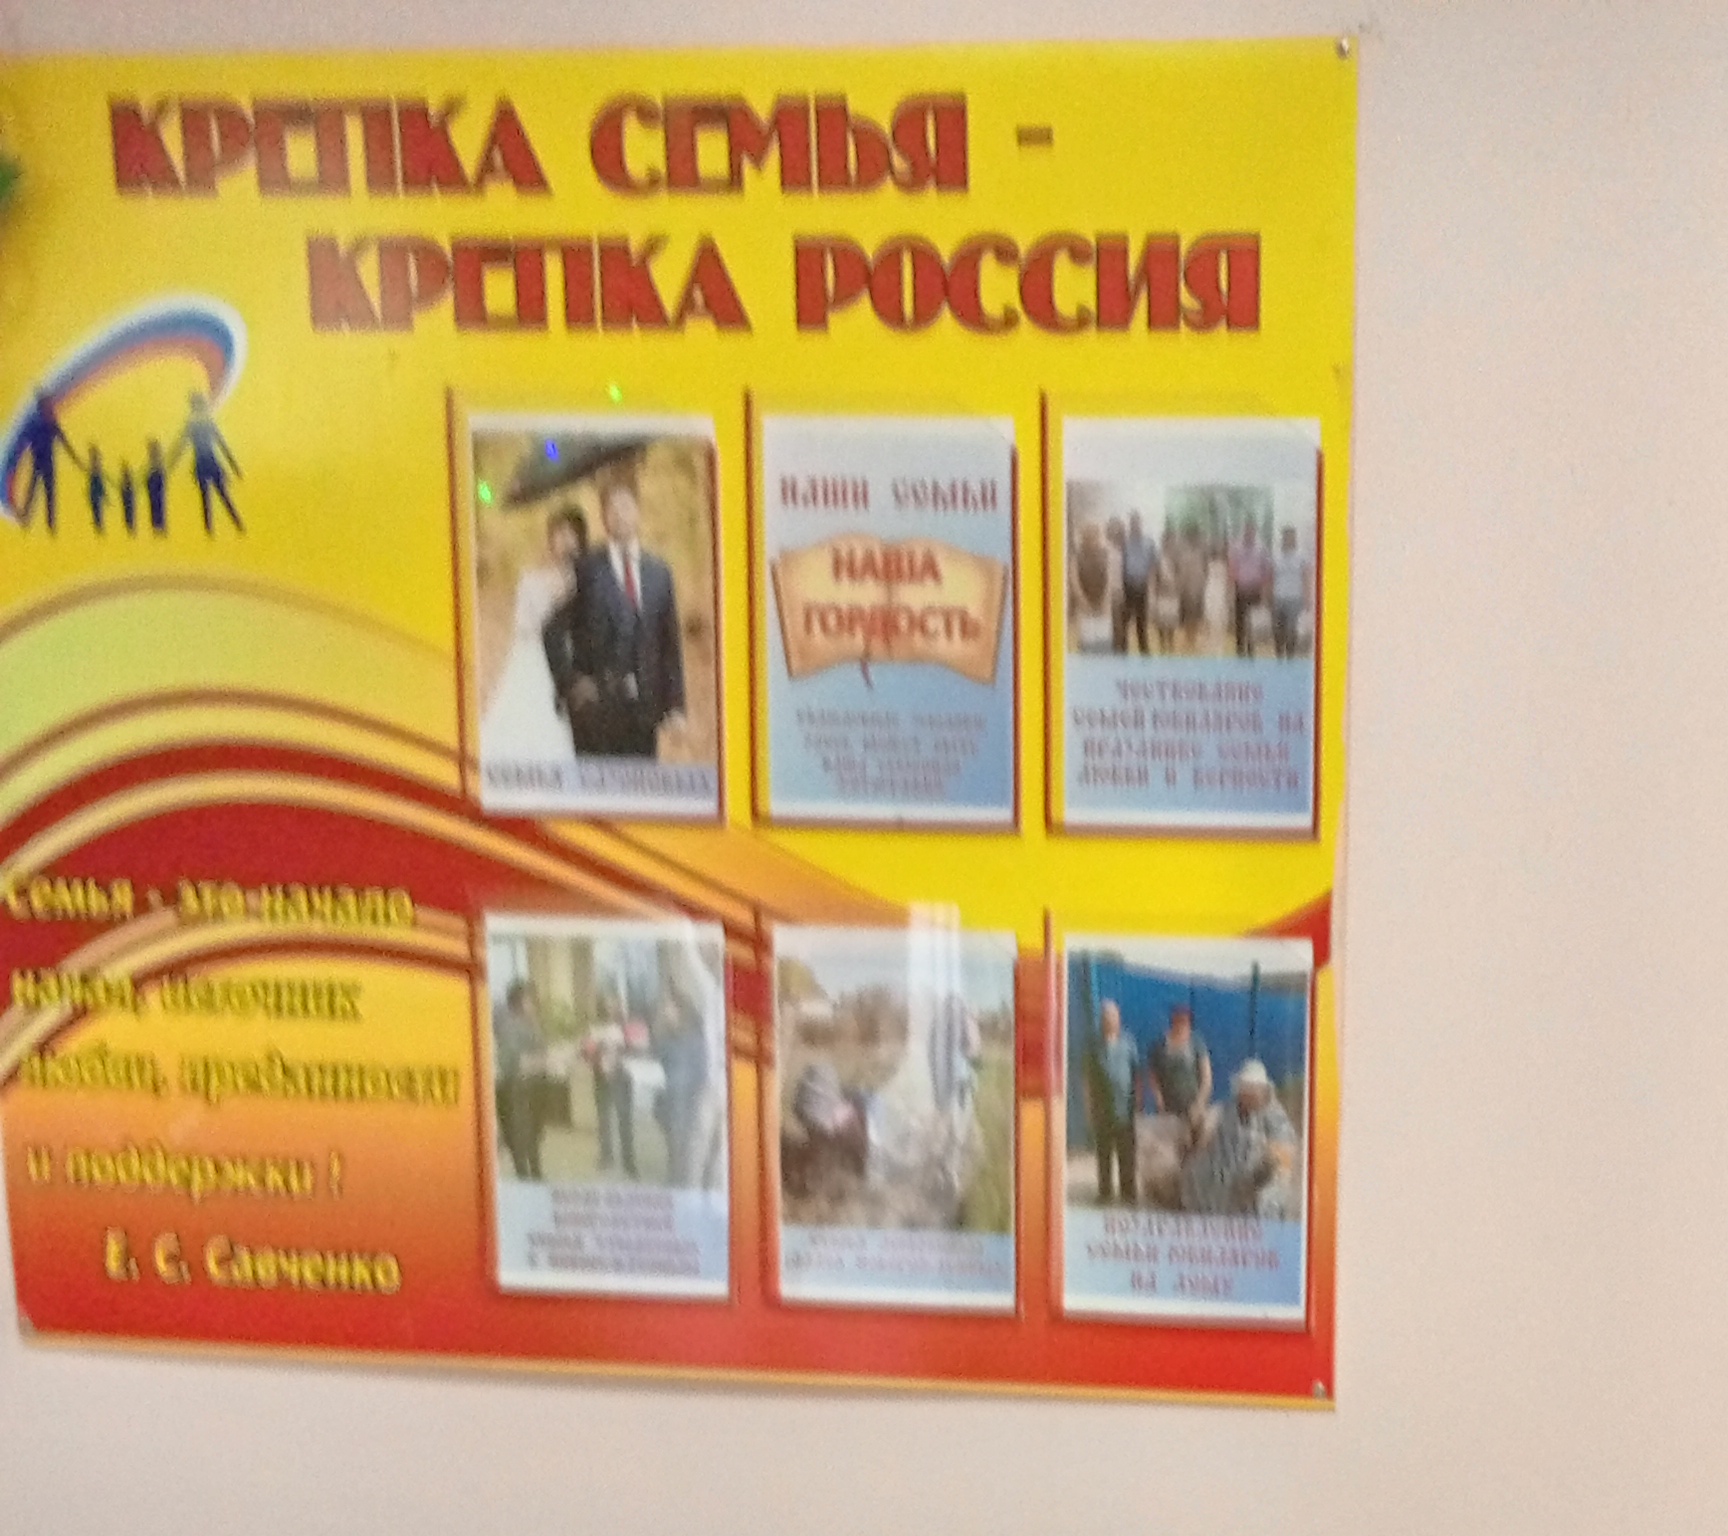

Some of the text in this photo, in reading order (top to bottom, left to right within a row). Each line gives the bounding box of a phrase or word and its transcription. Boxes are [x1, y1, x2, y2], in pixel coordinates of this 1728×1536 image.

[107, 92, 550, 198] КРЕПКА
[590, 92, 968, 197] СЕМЬЯ
[304, 231, 1260, 336] КРЕПКА РОССИЯ
[831, 547, 942, 584] НАША
[803, 604, 981, 641] ГОРДОСТЬ
[4, 877, 134, 920] Семья
[27, 1146, 51, 1184] и
[154, 1230, 192, 1285] С.
[204, 1233, 401, 1295] Савченко
